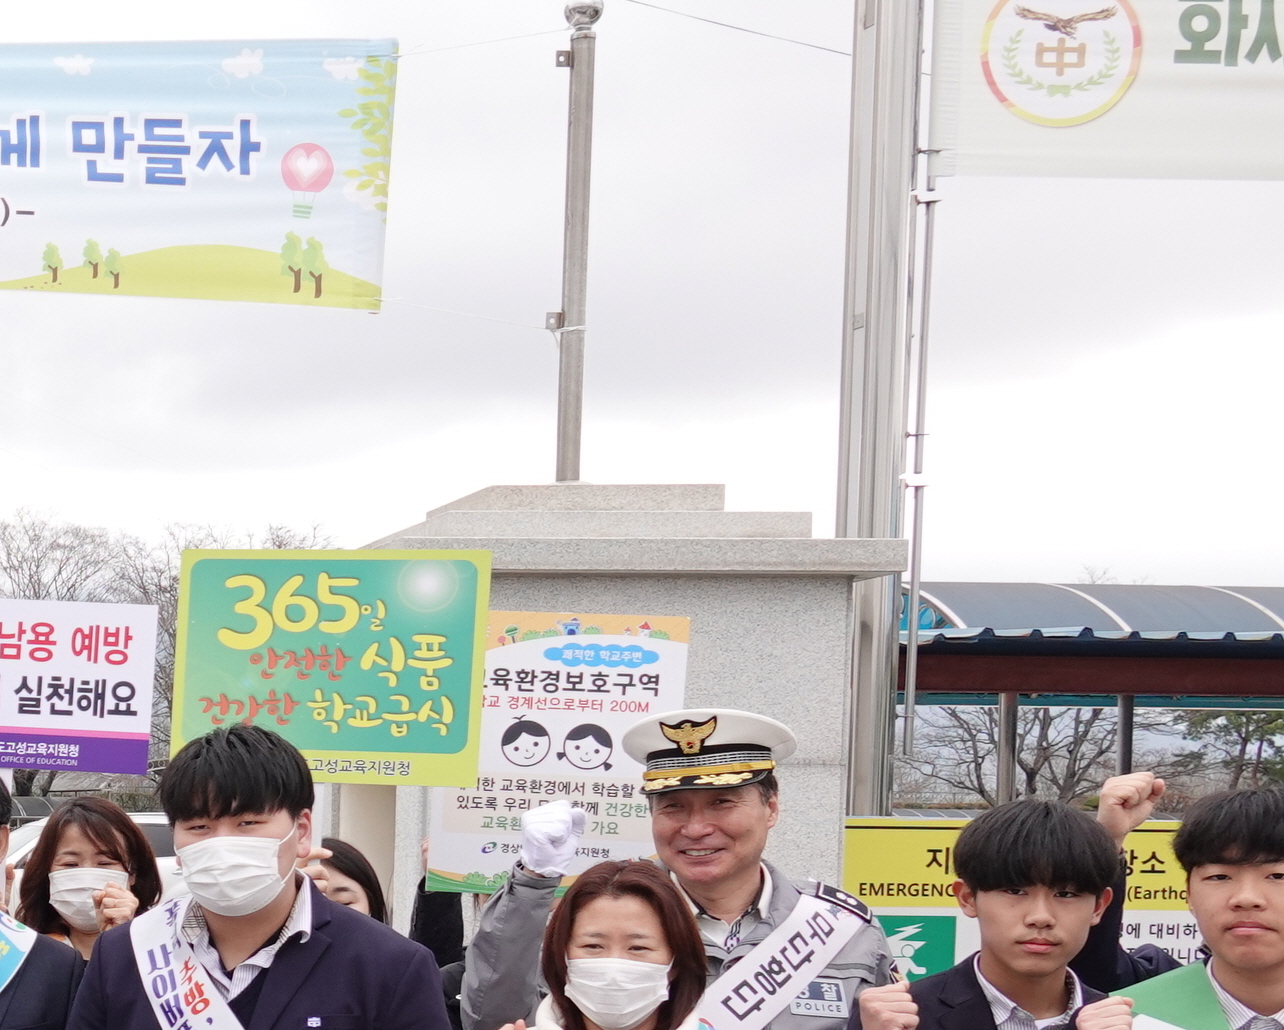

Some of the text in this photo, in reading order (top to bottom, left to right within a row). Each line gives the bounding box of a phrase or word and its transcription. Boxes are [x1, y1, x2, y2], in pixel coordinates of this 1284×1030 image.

[69, 114, 262, 187] 만들자
[71, 624, 133, 666] 예방
[249, 633, 453, 691] 안전한 식품
[13, 674, 138, 719] 실천해요
[484, 668, 660, 697] 육환경보호구역
[198, 689, 455, 737] 건강한 학교급식
[507, 696, 650, 713] 경계선으로부터 200M
[500, 778, 586, 796] 교육환경에서
[592, 783, 635, 799] 학습할
[457, 796, 498, 811] 있도록
[503, 798, 531, 811] 우리
[605, 802, 648, 817] 건강한
[796, 1002, 842, 1013] POLICE
